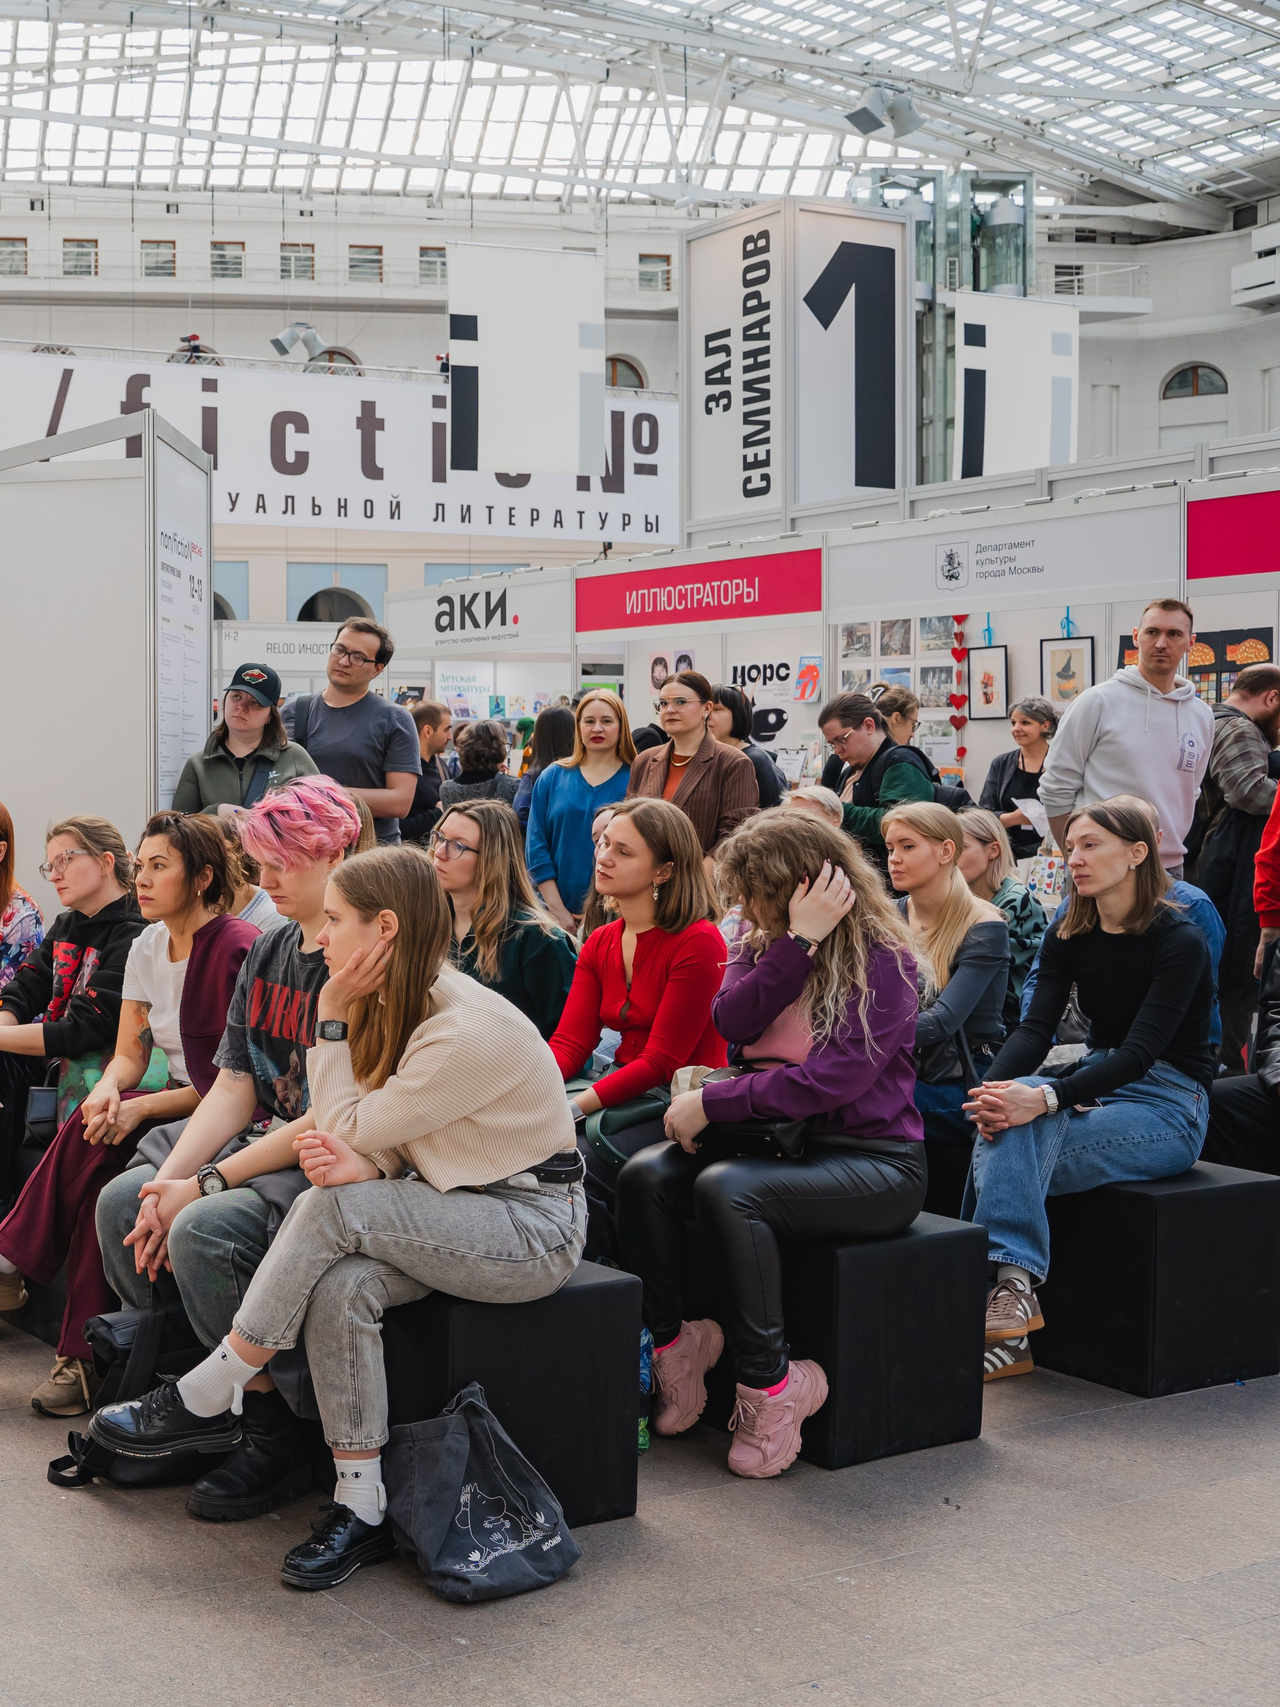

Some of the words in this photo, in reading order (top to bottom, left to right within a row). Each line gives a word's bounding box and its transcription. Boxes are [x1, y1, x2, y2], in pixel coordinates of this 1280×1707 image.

[742, 228, 771, 499] СЕМИНАРОВ
[803, 241, 896, 490] 1
[704, 328, 732, 416] ЗАЛ
[227, 491, 402, 521] УАЛЬНОЙ
[433, 503, 660, 534] ЛИТЕРАТУРЫ
[975, 540, 1035, 555] Департамент
[975, 555, 1016, 568] культуры
[975, 569, 1006, 580] города
[1008, 565, 1045, 576] Москвы
[626, 577, 759, 614] ИЛЛЮСТРАТОРЫ
[266, 642, 296, 654] RELOD
[298, 643, 330, 655] ИНОСТ
[439, 673, 477, 683] Детская
[439, 684, 491, 695] литература
